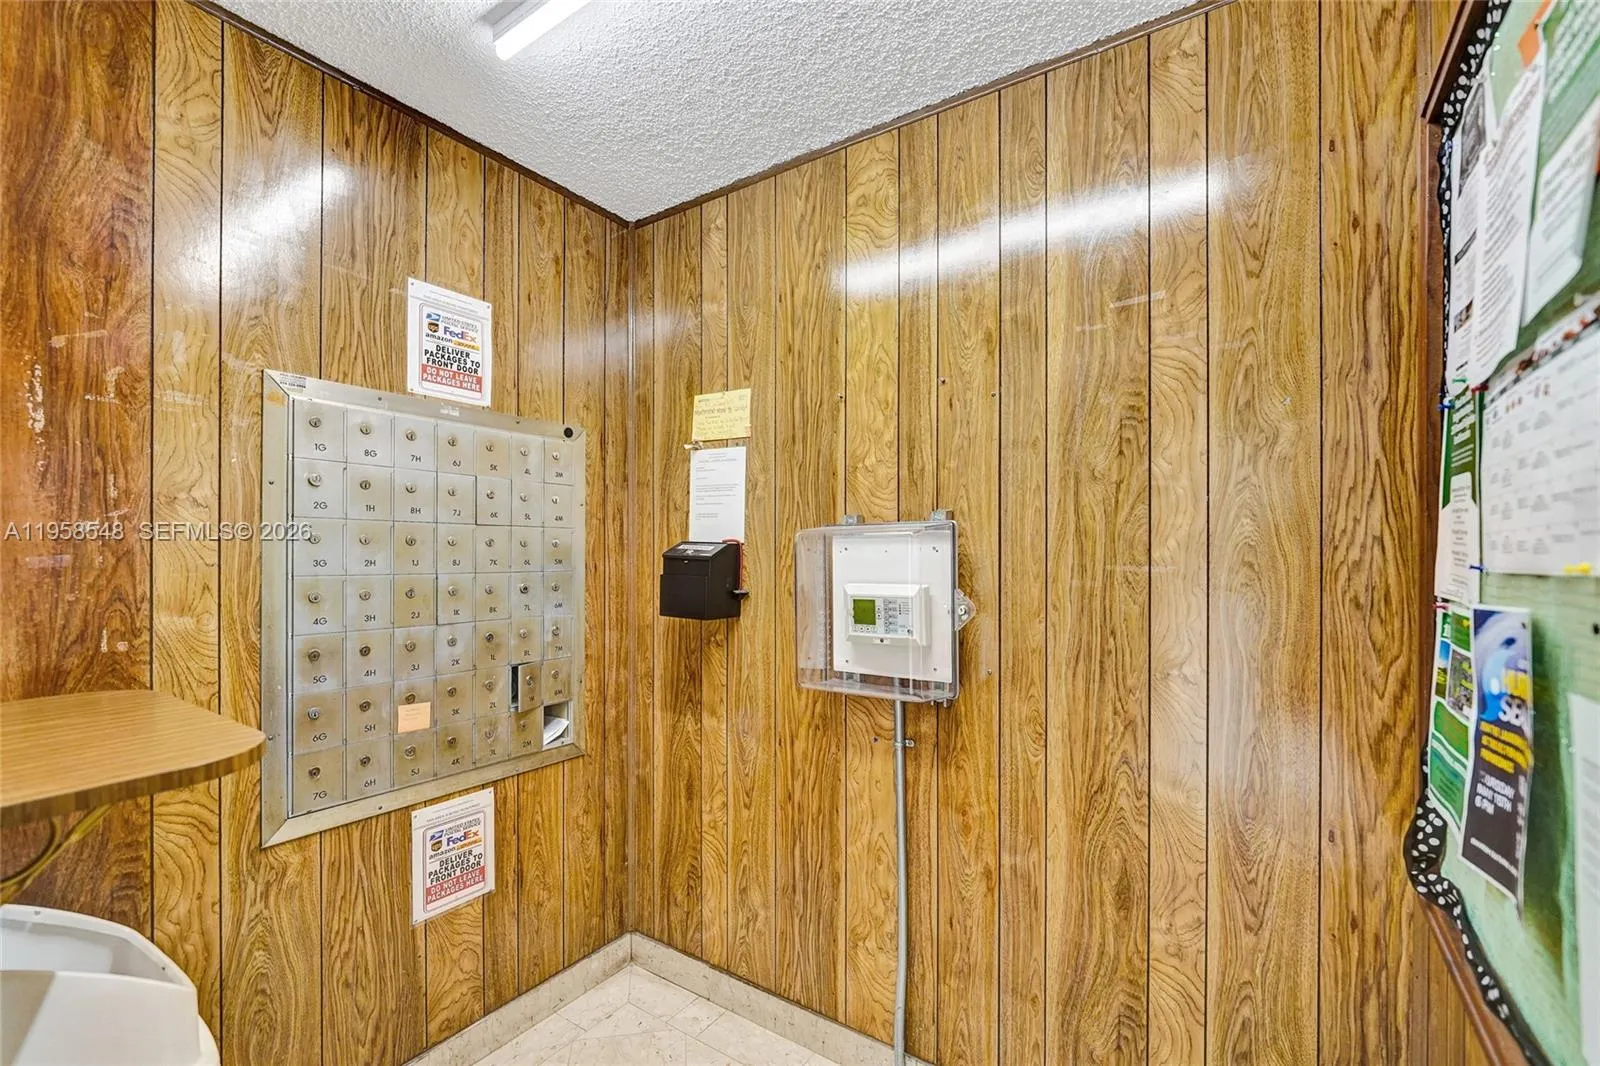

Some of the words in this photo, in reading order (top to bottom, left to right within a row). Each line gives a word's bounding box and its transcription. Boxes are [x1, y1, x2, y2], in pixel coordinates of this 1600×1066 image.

[425, 333, 452, 344] amazon
[444, 326, 476, 343] FedEx
[425, 349, 467, 365] PACKAGES
[436, 345, 470, 359] DELIVER
[427, 358, 454, 369] FRONT
[457, 364, 478, 375] DOOR
[423, 373, 461, 387] PACKAGES
[463, 382, 480, 390] HERE
[456, 373, 477, 384] LEAVE
[314, 444, 327, 452] 1G
[364, 449, 378, 457] 8G
[313, 675, 327, 684] 5G
[364, 724, 376, 732] 5H
[313, 732, 327, 742] 6G
[364, 779, 376, 788] 6H
[313, 791, 327, 800] 7G
[447, 829, 479, 847] FedEx
[429, 847, 455, 860] amazon
[440, 849, 473, 867] DELIVER
[428, 857, 470, 879] PACKAGES
[473, 852, 483, 861] TO
[430, 870, 458, 885] FRONT
[460, 861, 481, 873] DOOR
[427, 884, 465, 902] PACKAGES
[466, 876, 483, 887] HERE
[431, 886, 440, 895] DO
[444, 880, 457, 889] NOT
[460, 870, 480, 884] LEAVE
